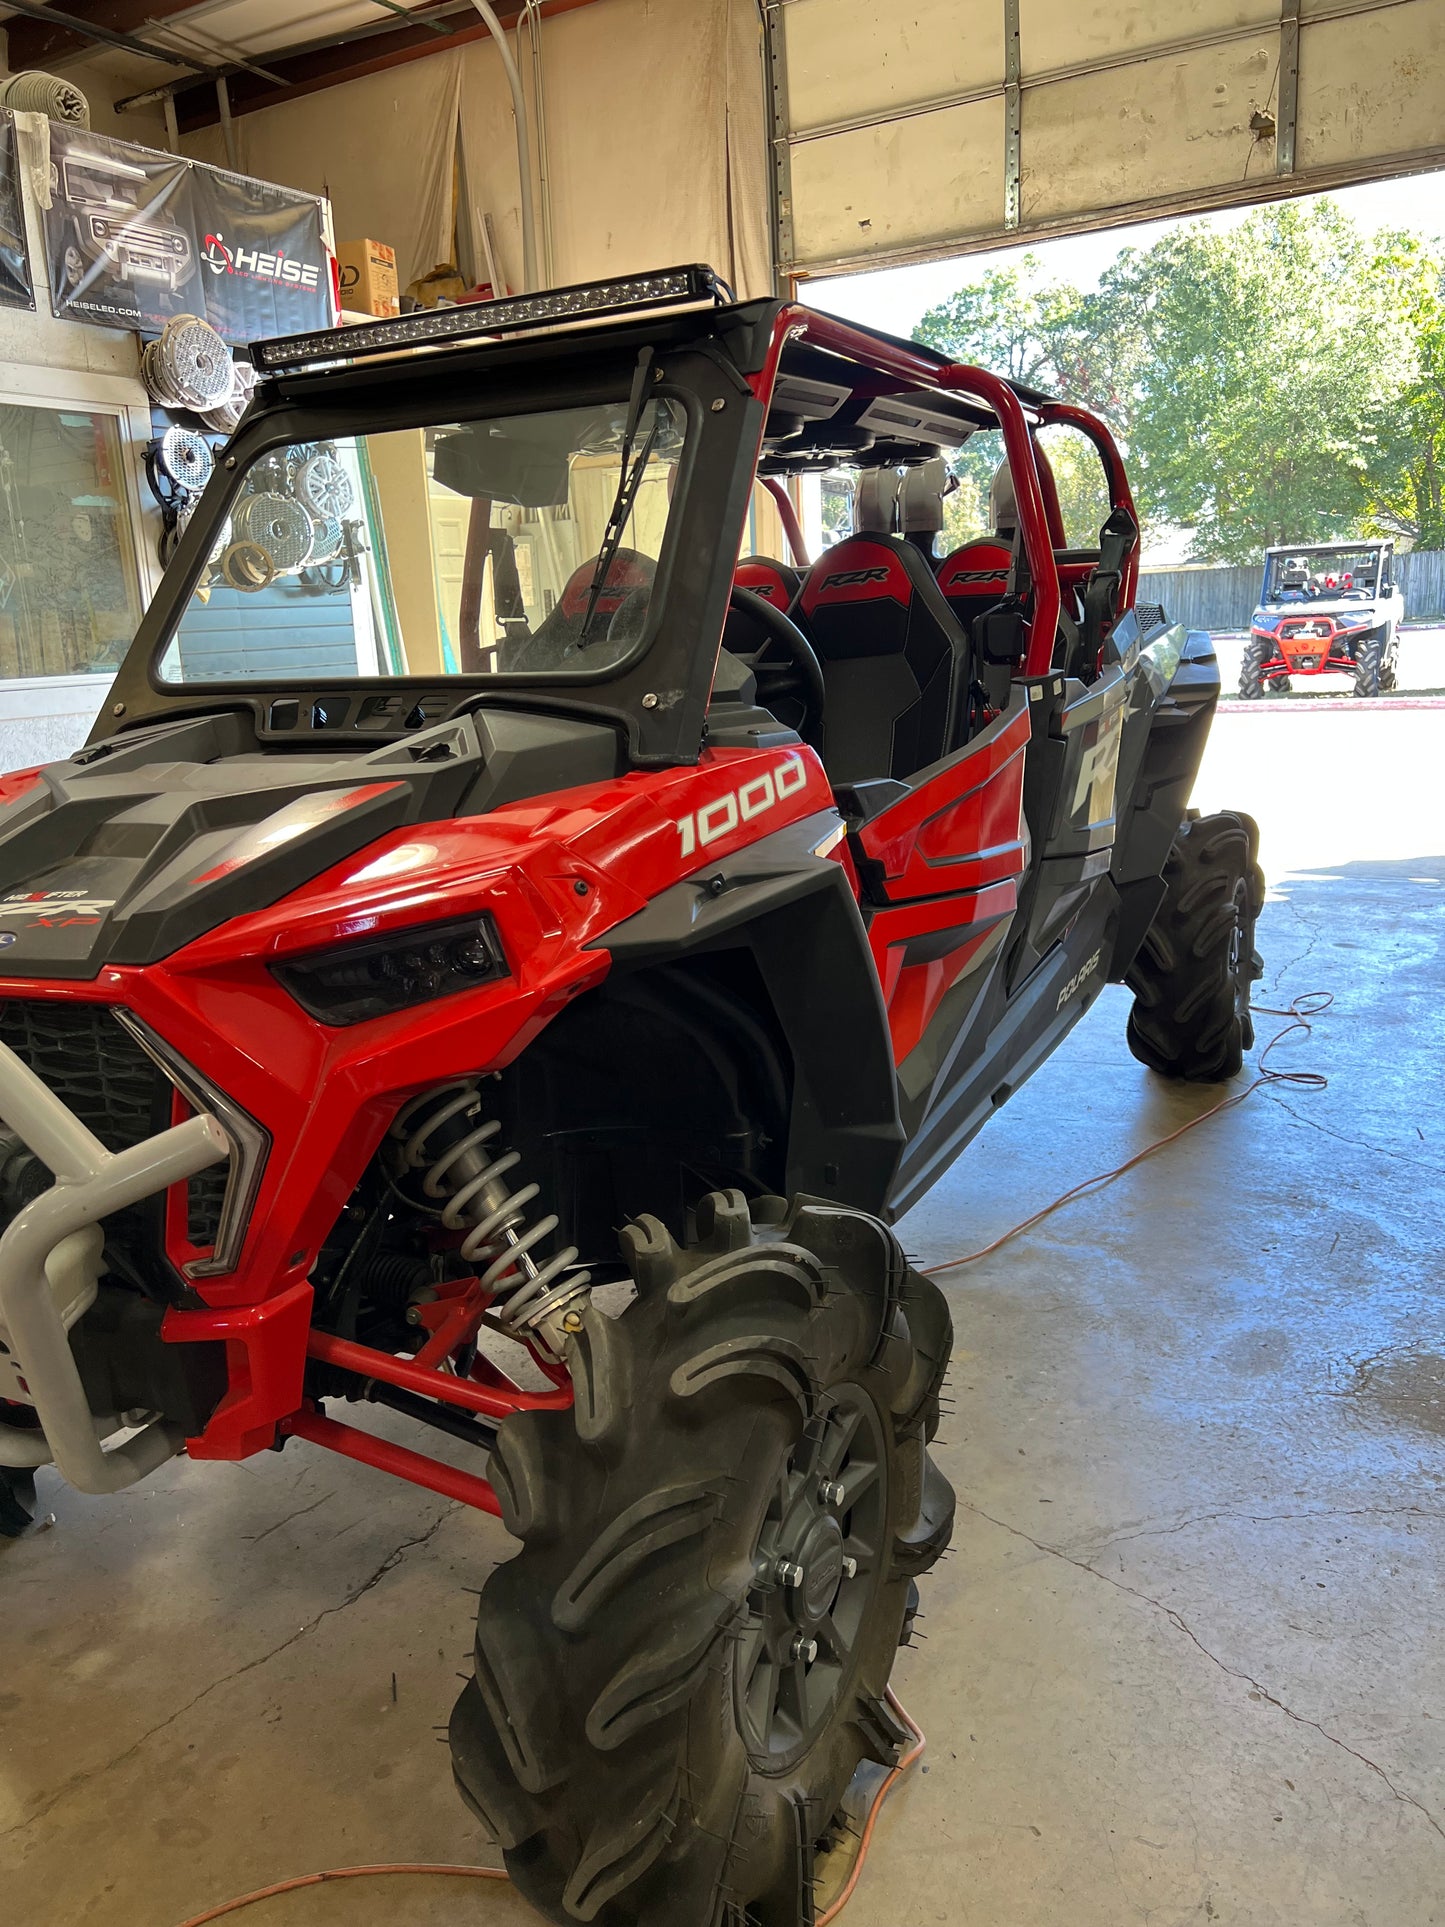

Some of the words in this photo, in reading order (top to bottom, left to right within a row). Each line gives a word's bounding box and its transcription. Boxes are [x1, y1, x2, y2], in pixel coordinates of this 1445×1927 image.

[235, 249, 320, 286] HEISE
[65, 299, 142, 318] HEISELED.COM
[819, 567, 890, 591] RZR
[677, 755, 807, 858] 1000
[0, 900, 116, 917] ZR
[25, 917, 102, 928] XP
[1056, 948, 1101, 1012] POLARIS
